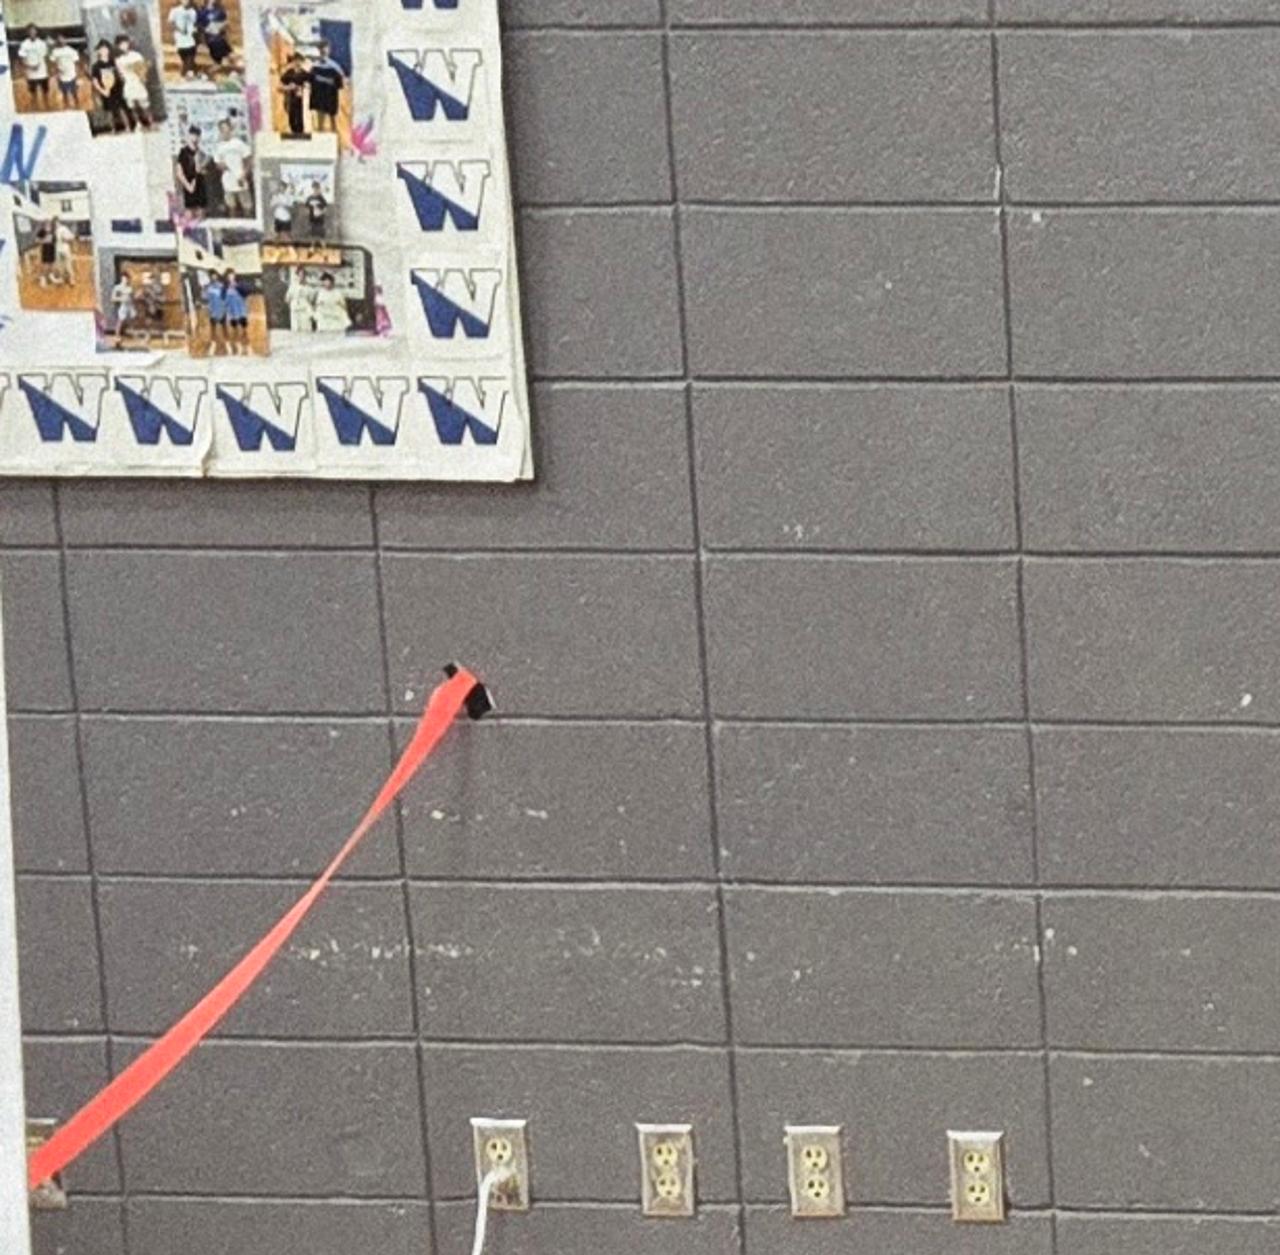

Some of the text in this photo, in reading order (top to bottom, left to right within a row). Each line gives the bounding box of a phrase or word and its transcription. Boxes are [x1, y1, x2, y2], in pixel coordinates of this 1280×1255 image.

[387, 48, 483, 121] W
[397, 160, 491, 231] W
[410, 268, 501, 338] W
[17, 372, 110, 442] W
[114, 375, 208, 445] W
[216, 382, 308, 452] W
[316, 376, 409, 446] W
[418, 376, 508, 445] W
